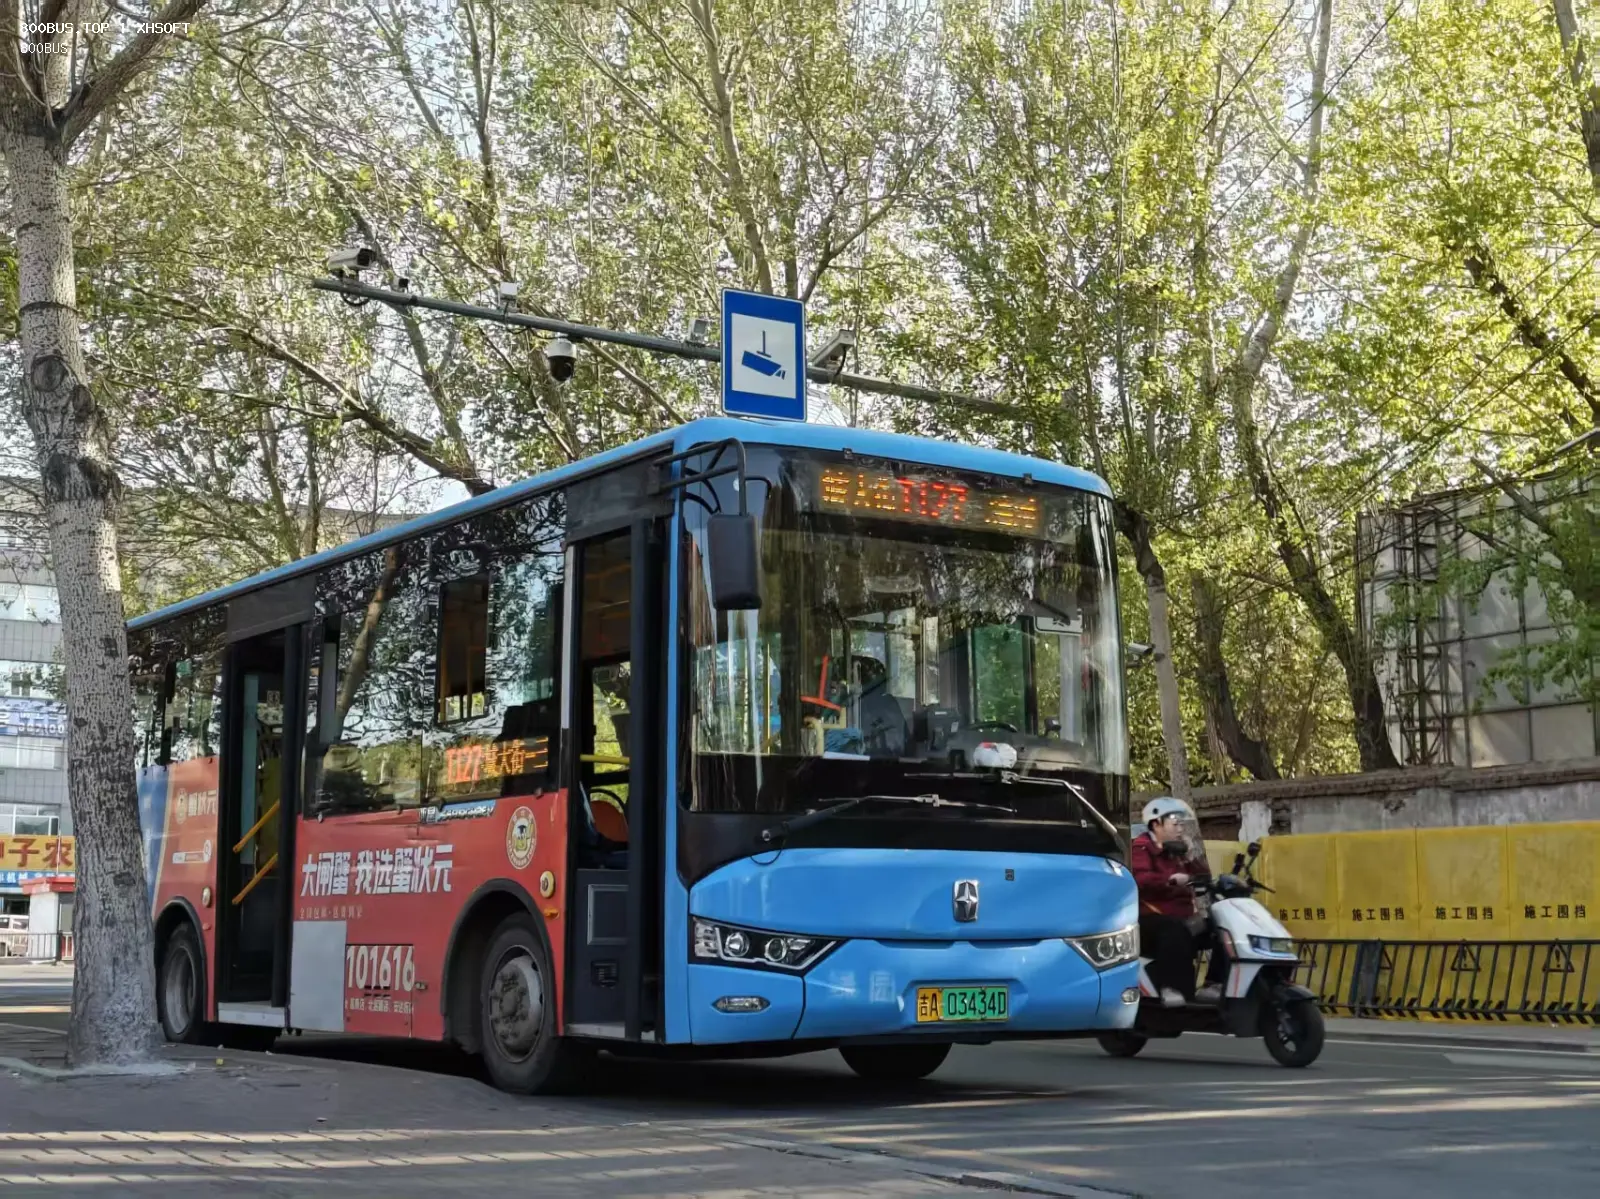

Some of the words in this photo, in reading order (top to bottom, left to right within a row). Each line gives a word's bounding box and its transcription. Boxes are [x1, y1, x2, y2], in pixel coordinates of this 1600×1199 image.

[301, 852, 351, 897] 大闸蟹
[355, 844, 453, 895] 我选蟹状元
[1279, 907, 1326, 921] 施工围挡
[1352, 907, 1405, 921] 施工围挡
[1435, 906, 1493, 920] 施工围挡
[1524, 904, 1586, 919] 施工围挡
[346, 945, 415, 992] 101616
[947, 991, 1006, 1016] 03434D
